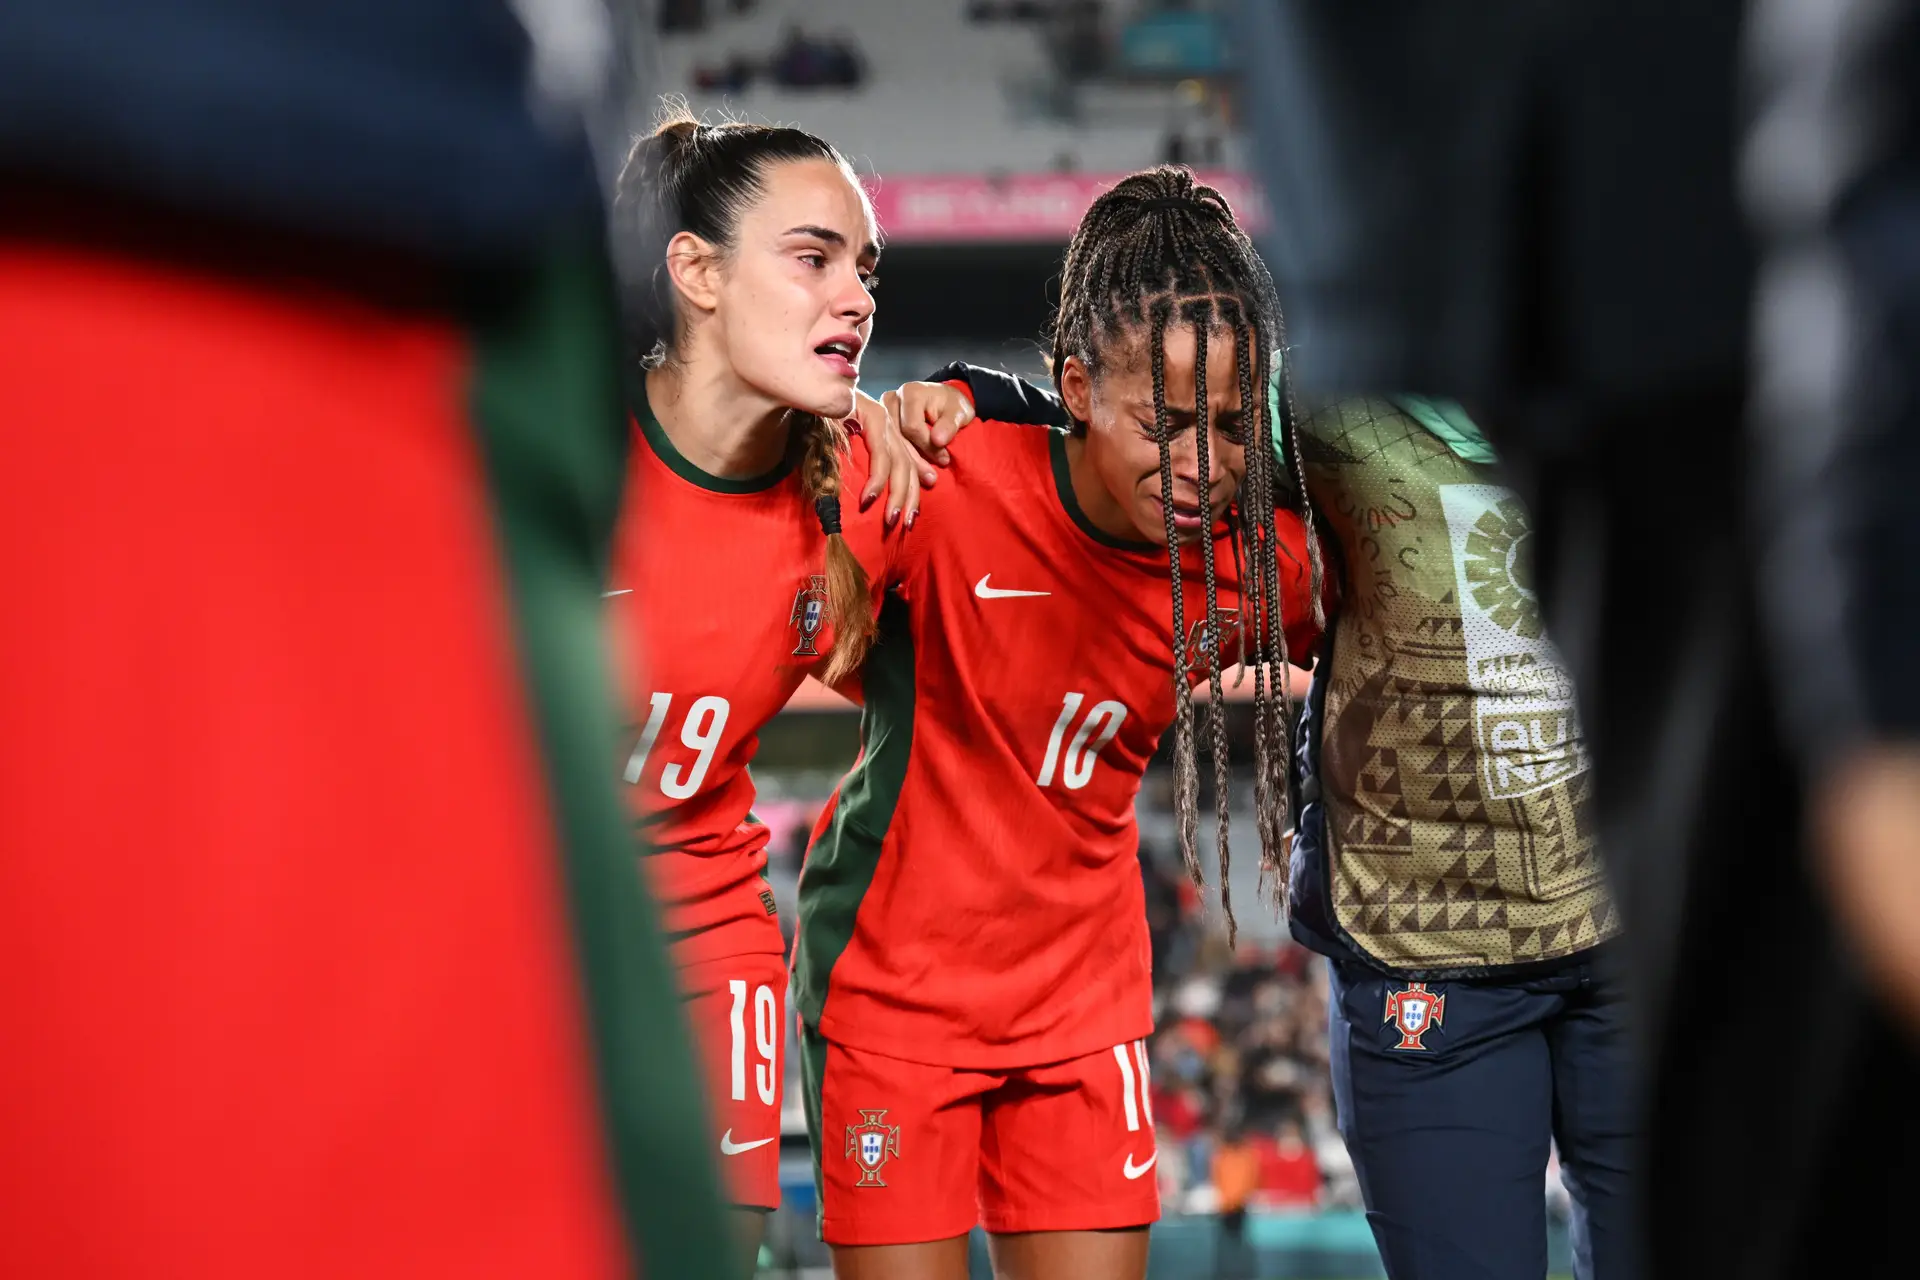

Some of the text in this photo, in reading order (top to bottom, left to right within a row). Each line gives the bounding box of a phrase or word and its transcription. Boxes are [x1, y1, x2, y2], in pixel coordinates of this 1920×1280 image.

[1478, 653, 1538, 676] FIFA
[1490, 685, 1573, 705] WORLD
[623, 691, 731, 799] 19
[1037, 691, 1128, 790] 10
[729, 979, 776, 1106] 19
